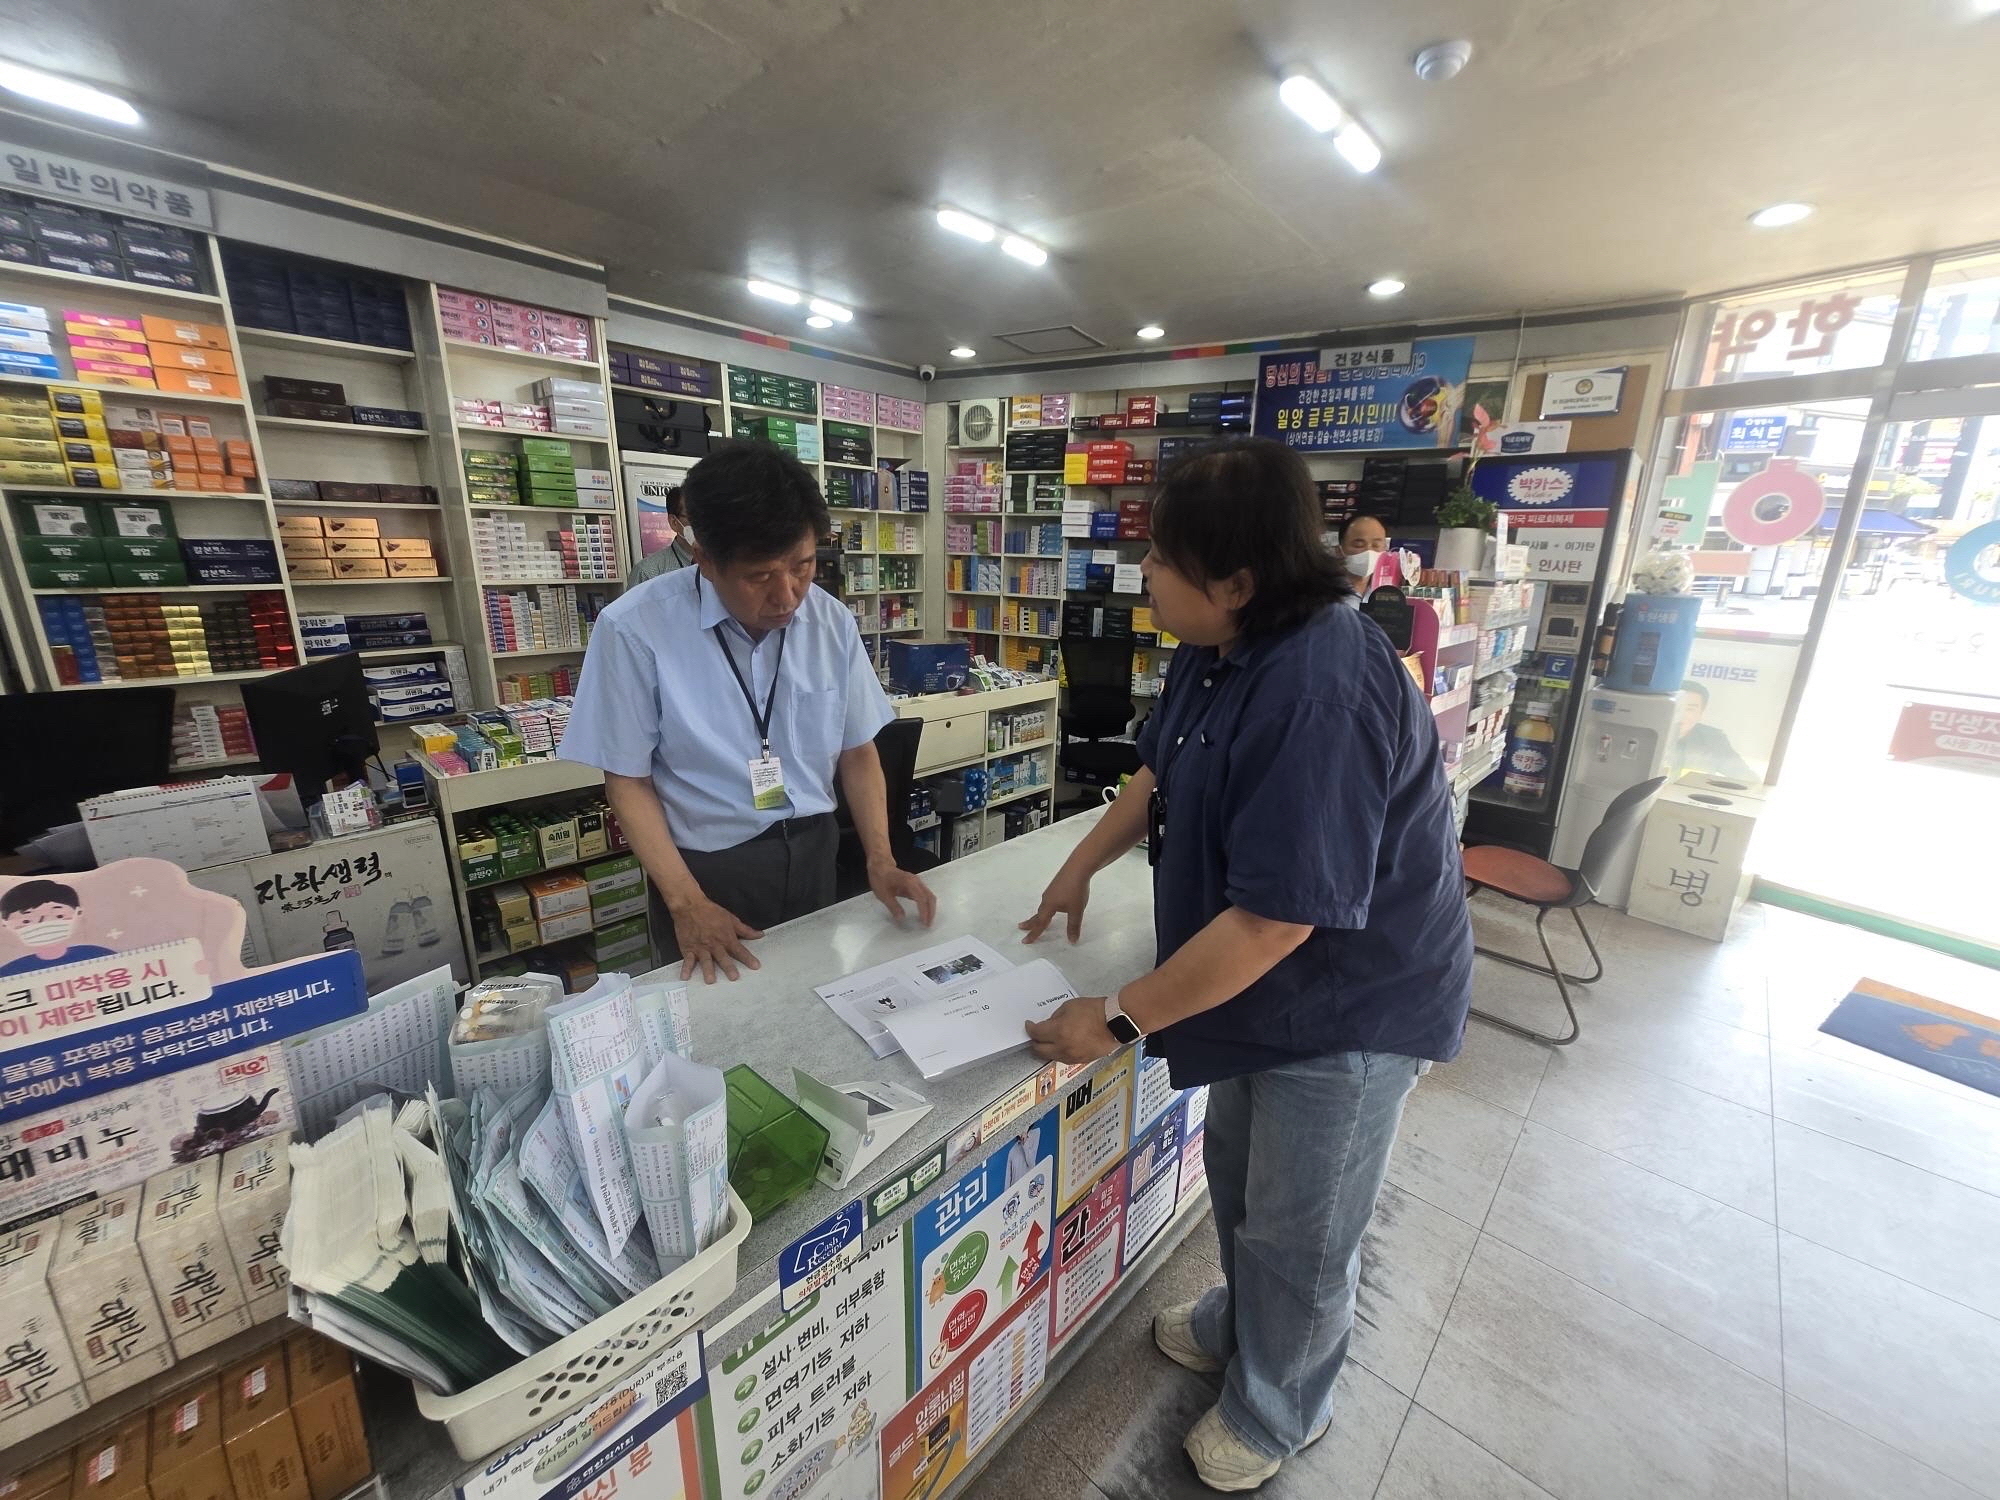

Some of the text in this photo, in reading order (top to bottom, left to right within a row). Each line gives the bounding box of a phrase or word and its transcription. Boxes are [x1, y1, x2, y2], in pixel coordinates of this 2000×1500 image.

[7, 153, 195, 219] 일반의약품
[1334, 349, 1394, 366] 건강식품
[1278, 402, 1397, 429] 일양 글루코사민!!!
[1299, 388, 1319, 404] 건강한
[1321, 387, 1341, 403] 관절과
[1360, 384, 1375, 400] 위한
[1519, 475, 1564, 491] 박카스
[1528, 514, 1574, 525] 피로회복제
[1538, 559, 1583, 574] 인사탄
[89, 807, 98, 818] 7
[255, 852, 382, 905] 자하생력
[0, 959, 168, 1014] 크 미착용 시
[38, 981, 185, 1030] 제한됩니다.
[1, 979, 336, 1083] 물을 포함한 음료섭취 제한됩니다.
[0, 1017, 274, 1105] 부에서 복용 부탁드립니다.
[935, 1171, 987, 1237] 관리
[807, 1240, 843, 1272] Receipt
[813, 1235, 839, 1259] Cash
[1061, 1205, 1090, 1266] 간
[805, 1254, 842, 1285] 현금영수증
[836, 1269, 885, 1319] 더부룩함
[951, 1312, 976, 1340] 비타민
[765, 1313, 870, 1411] 면역기능 저하
[767, 1356, 856, 1442] 피부 트러블
[770, 1371, 872, 1473] 소화기능 저하
[915, 1371, 965, 1426] 아로나민
[916, 1387, 965, 1440] 프리미엄
[483, 1475, 508, 1496] 내가
[656, 1351, 683, 1372] 부작용
[582, 1434, 634, 1477] 대한약사회
[629, 1446, 652, 1479] 분
